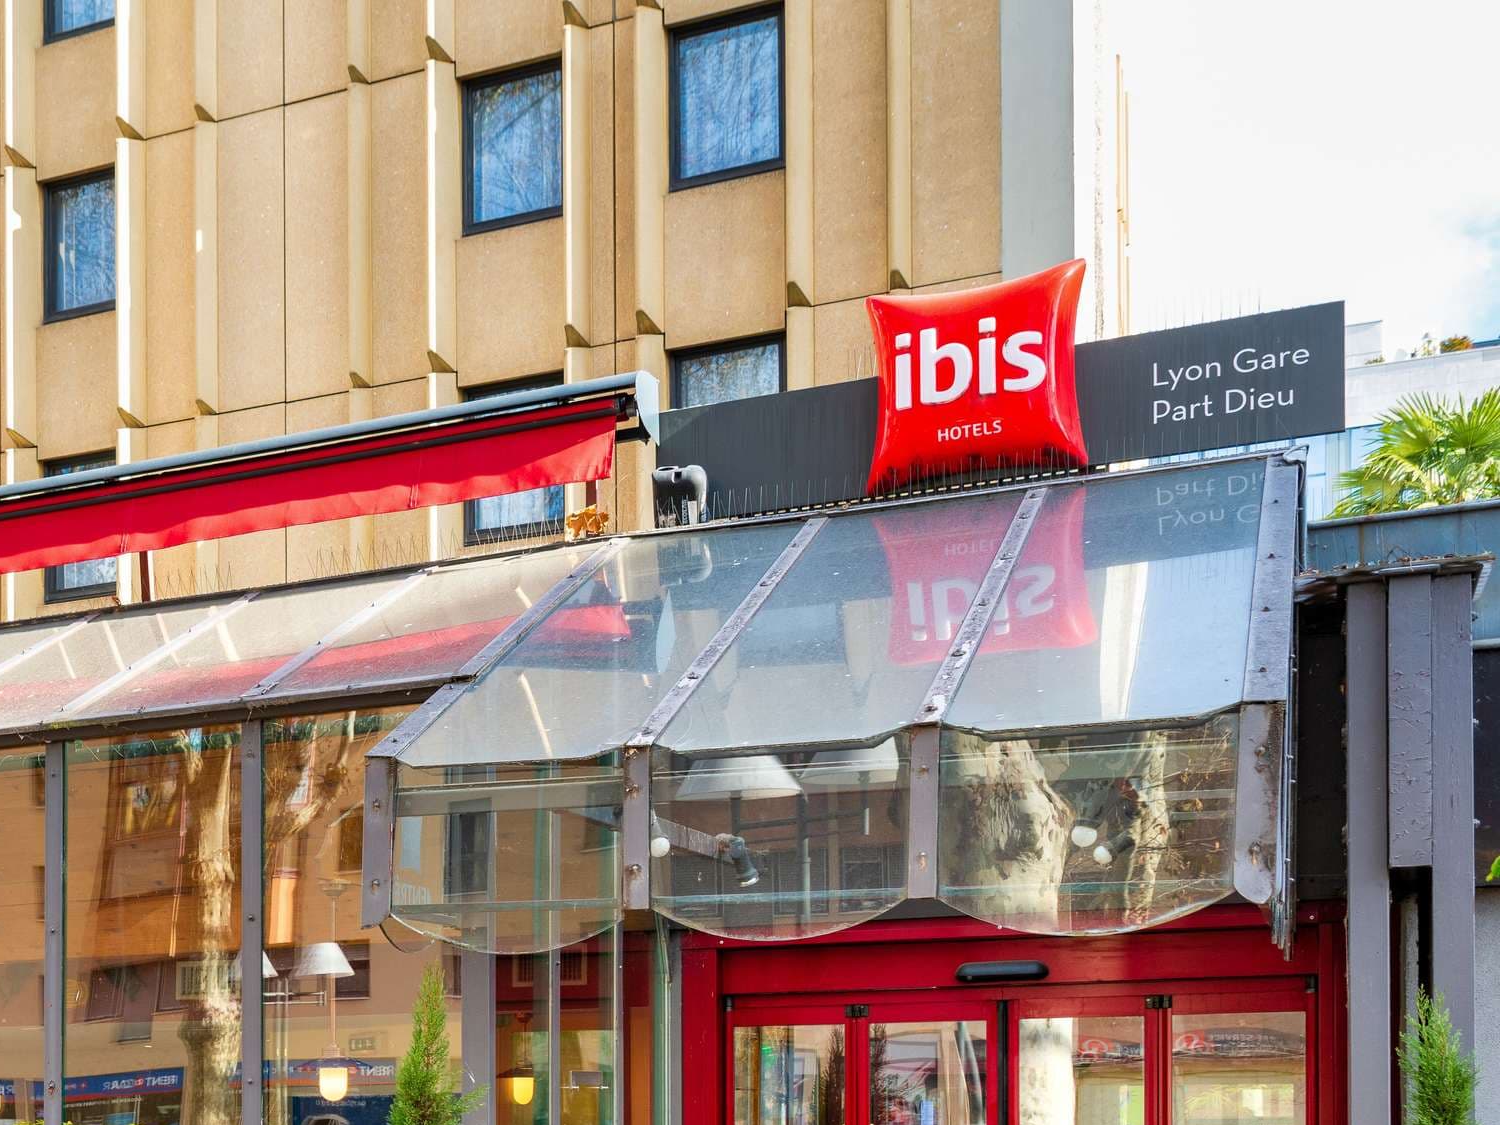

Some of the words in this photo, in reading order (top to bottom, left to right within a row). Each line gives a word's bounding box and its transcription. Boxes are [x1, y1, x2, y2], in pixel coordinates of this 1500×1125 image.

[895, 317, 1047, 411] ibis
[1153, 362, 1222, 391] Lyon
[1233, 348, 1310, 373] Gare
[1153, 400, 1214, 424] Part
[1225, 388, 1294, 414] Dieu
[937, 419, 1003, 442] HOTELS
